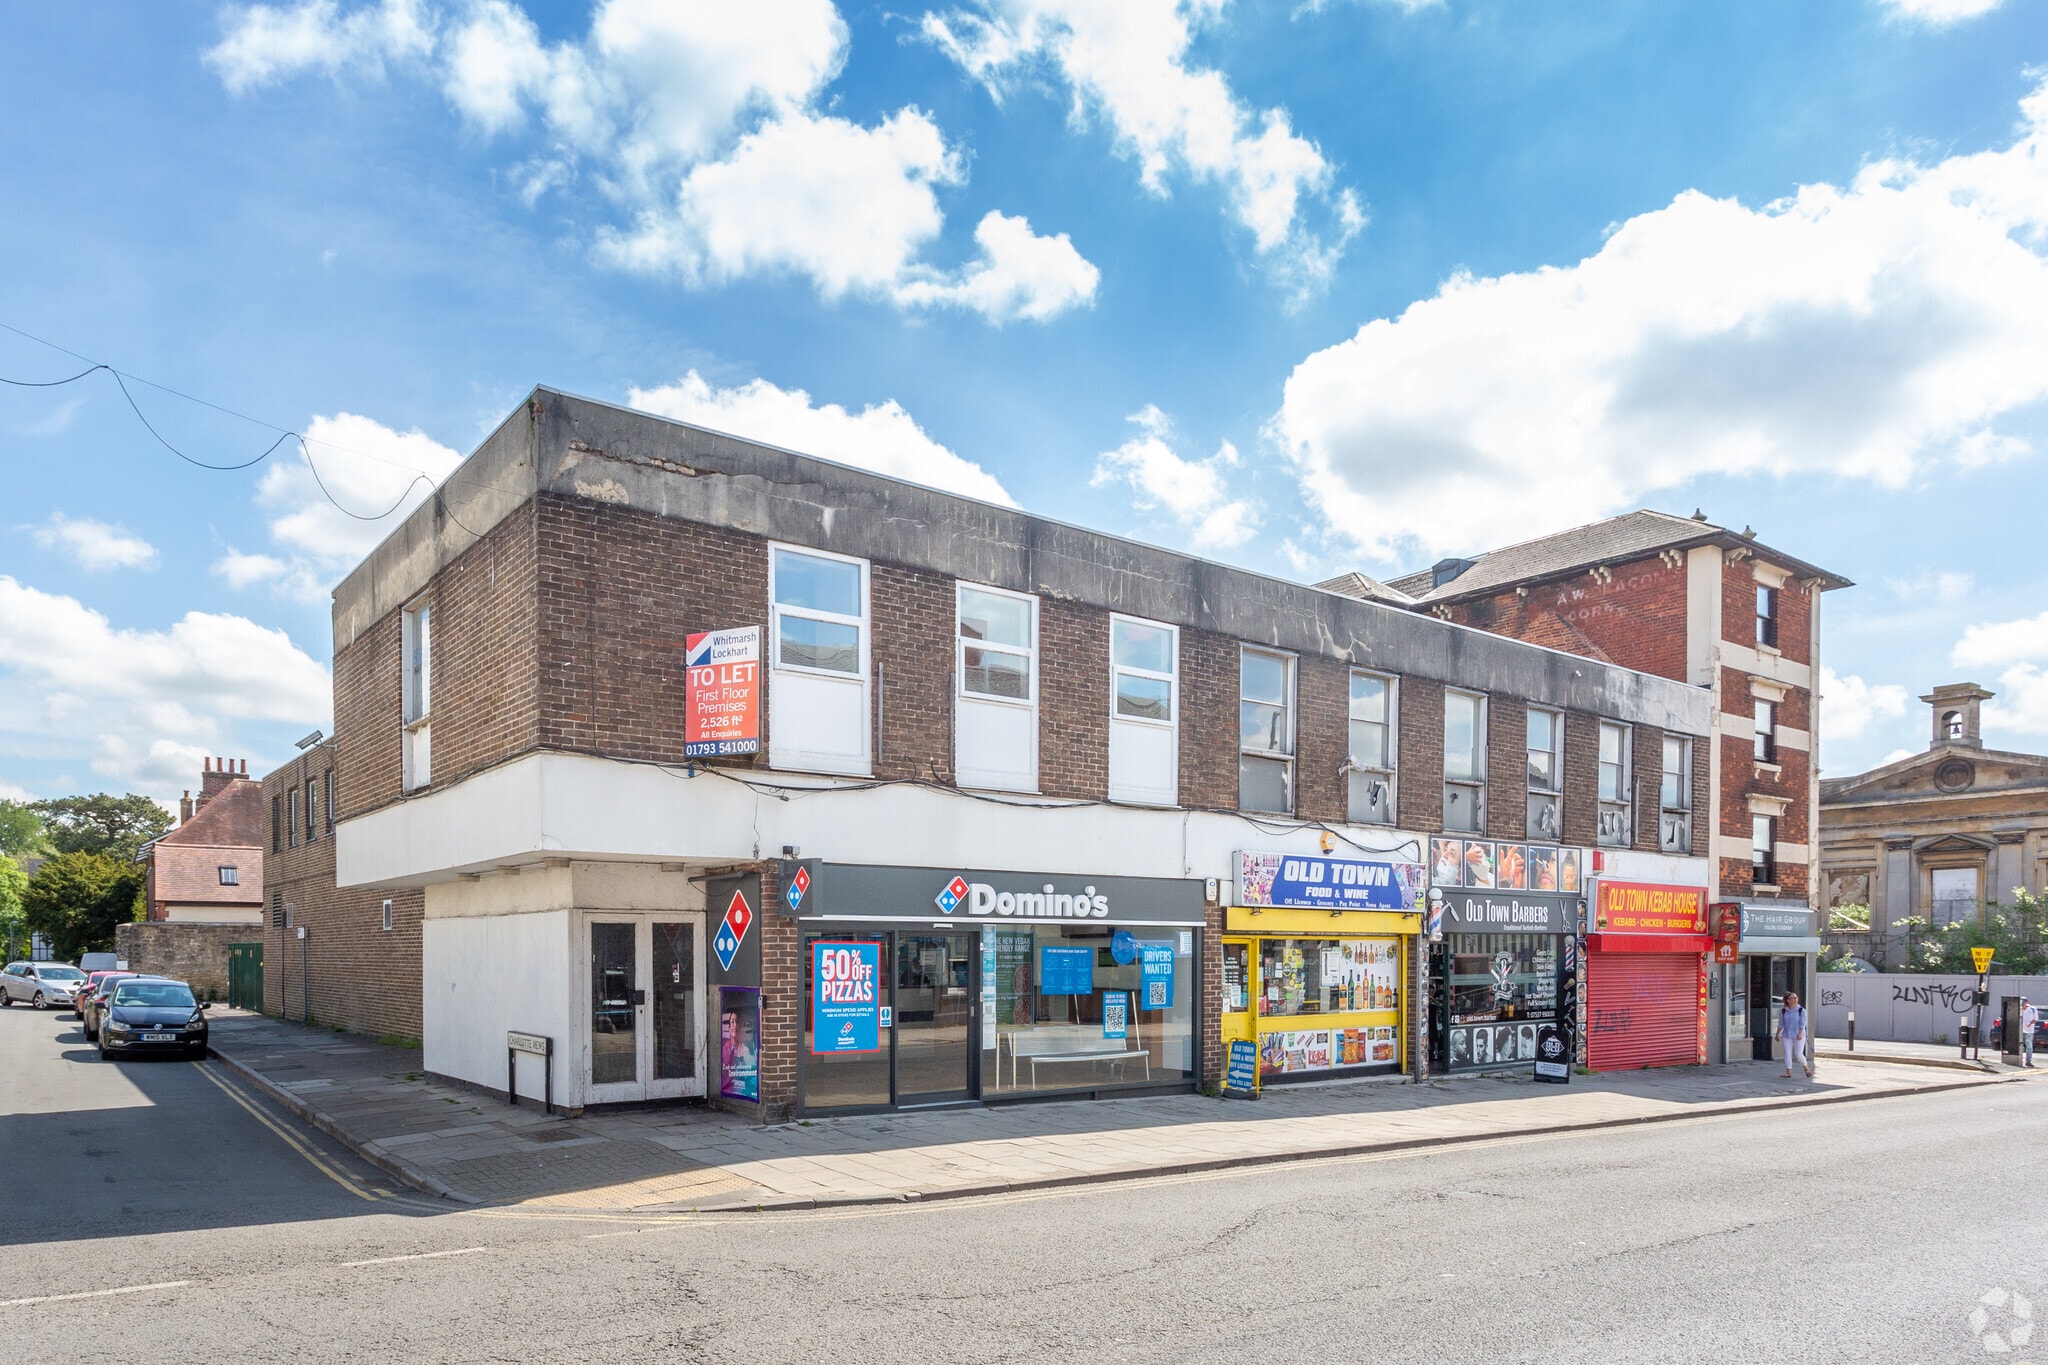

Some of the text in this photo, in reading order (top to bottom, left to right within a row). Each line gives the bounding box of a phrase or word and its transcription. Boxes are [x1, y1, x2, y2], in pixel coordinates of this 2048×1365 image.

[713, 633, 756, 646] Whitmarsh
[712, 646, 748, 658] Lockhart
[690, 663, 756, 687] TO LET
[696, 687, 749, 703] First Floor
[698, 701, 746, 714] Premises
[700, 716, 729, 729] 2,526
[701, 729, 742, 739] All Enquiries
[686, 741, 757, 756] 01793 541000
[1284, 861, 1390, 887] OLD TOWN
[968, 883, 1109, 917] Domino's
[1305, 887, 1369, 900] FOOD & WINE
[1609, 888, 1697, 914] OLD TOWN KEBAB HOUSE
[1613, 917, 1691, 928] KEBABS CHICKEN BURGERS
[1144, 951, 1171, 962] DRIVERS
[821, 949, 862, 981] 50%
[852, 964, 873, 980] OFF
[1144, 963, 1172, 974] WANTED
[821, 981, 874, 1003] PIZZAS
[510, 1035, 545, 1051] CHARLOTTE MEWS
[729, 1069, 757, 1077] Environment
